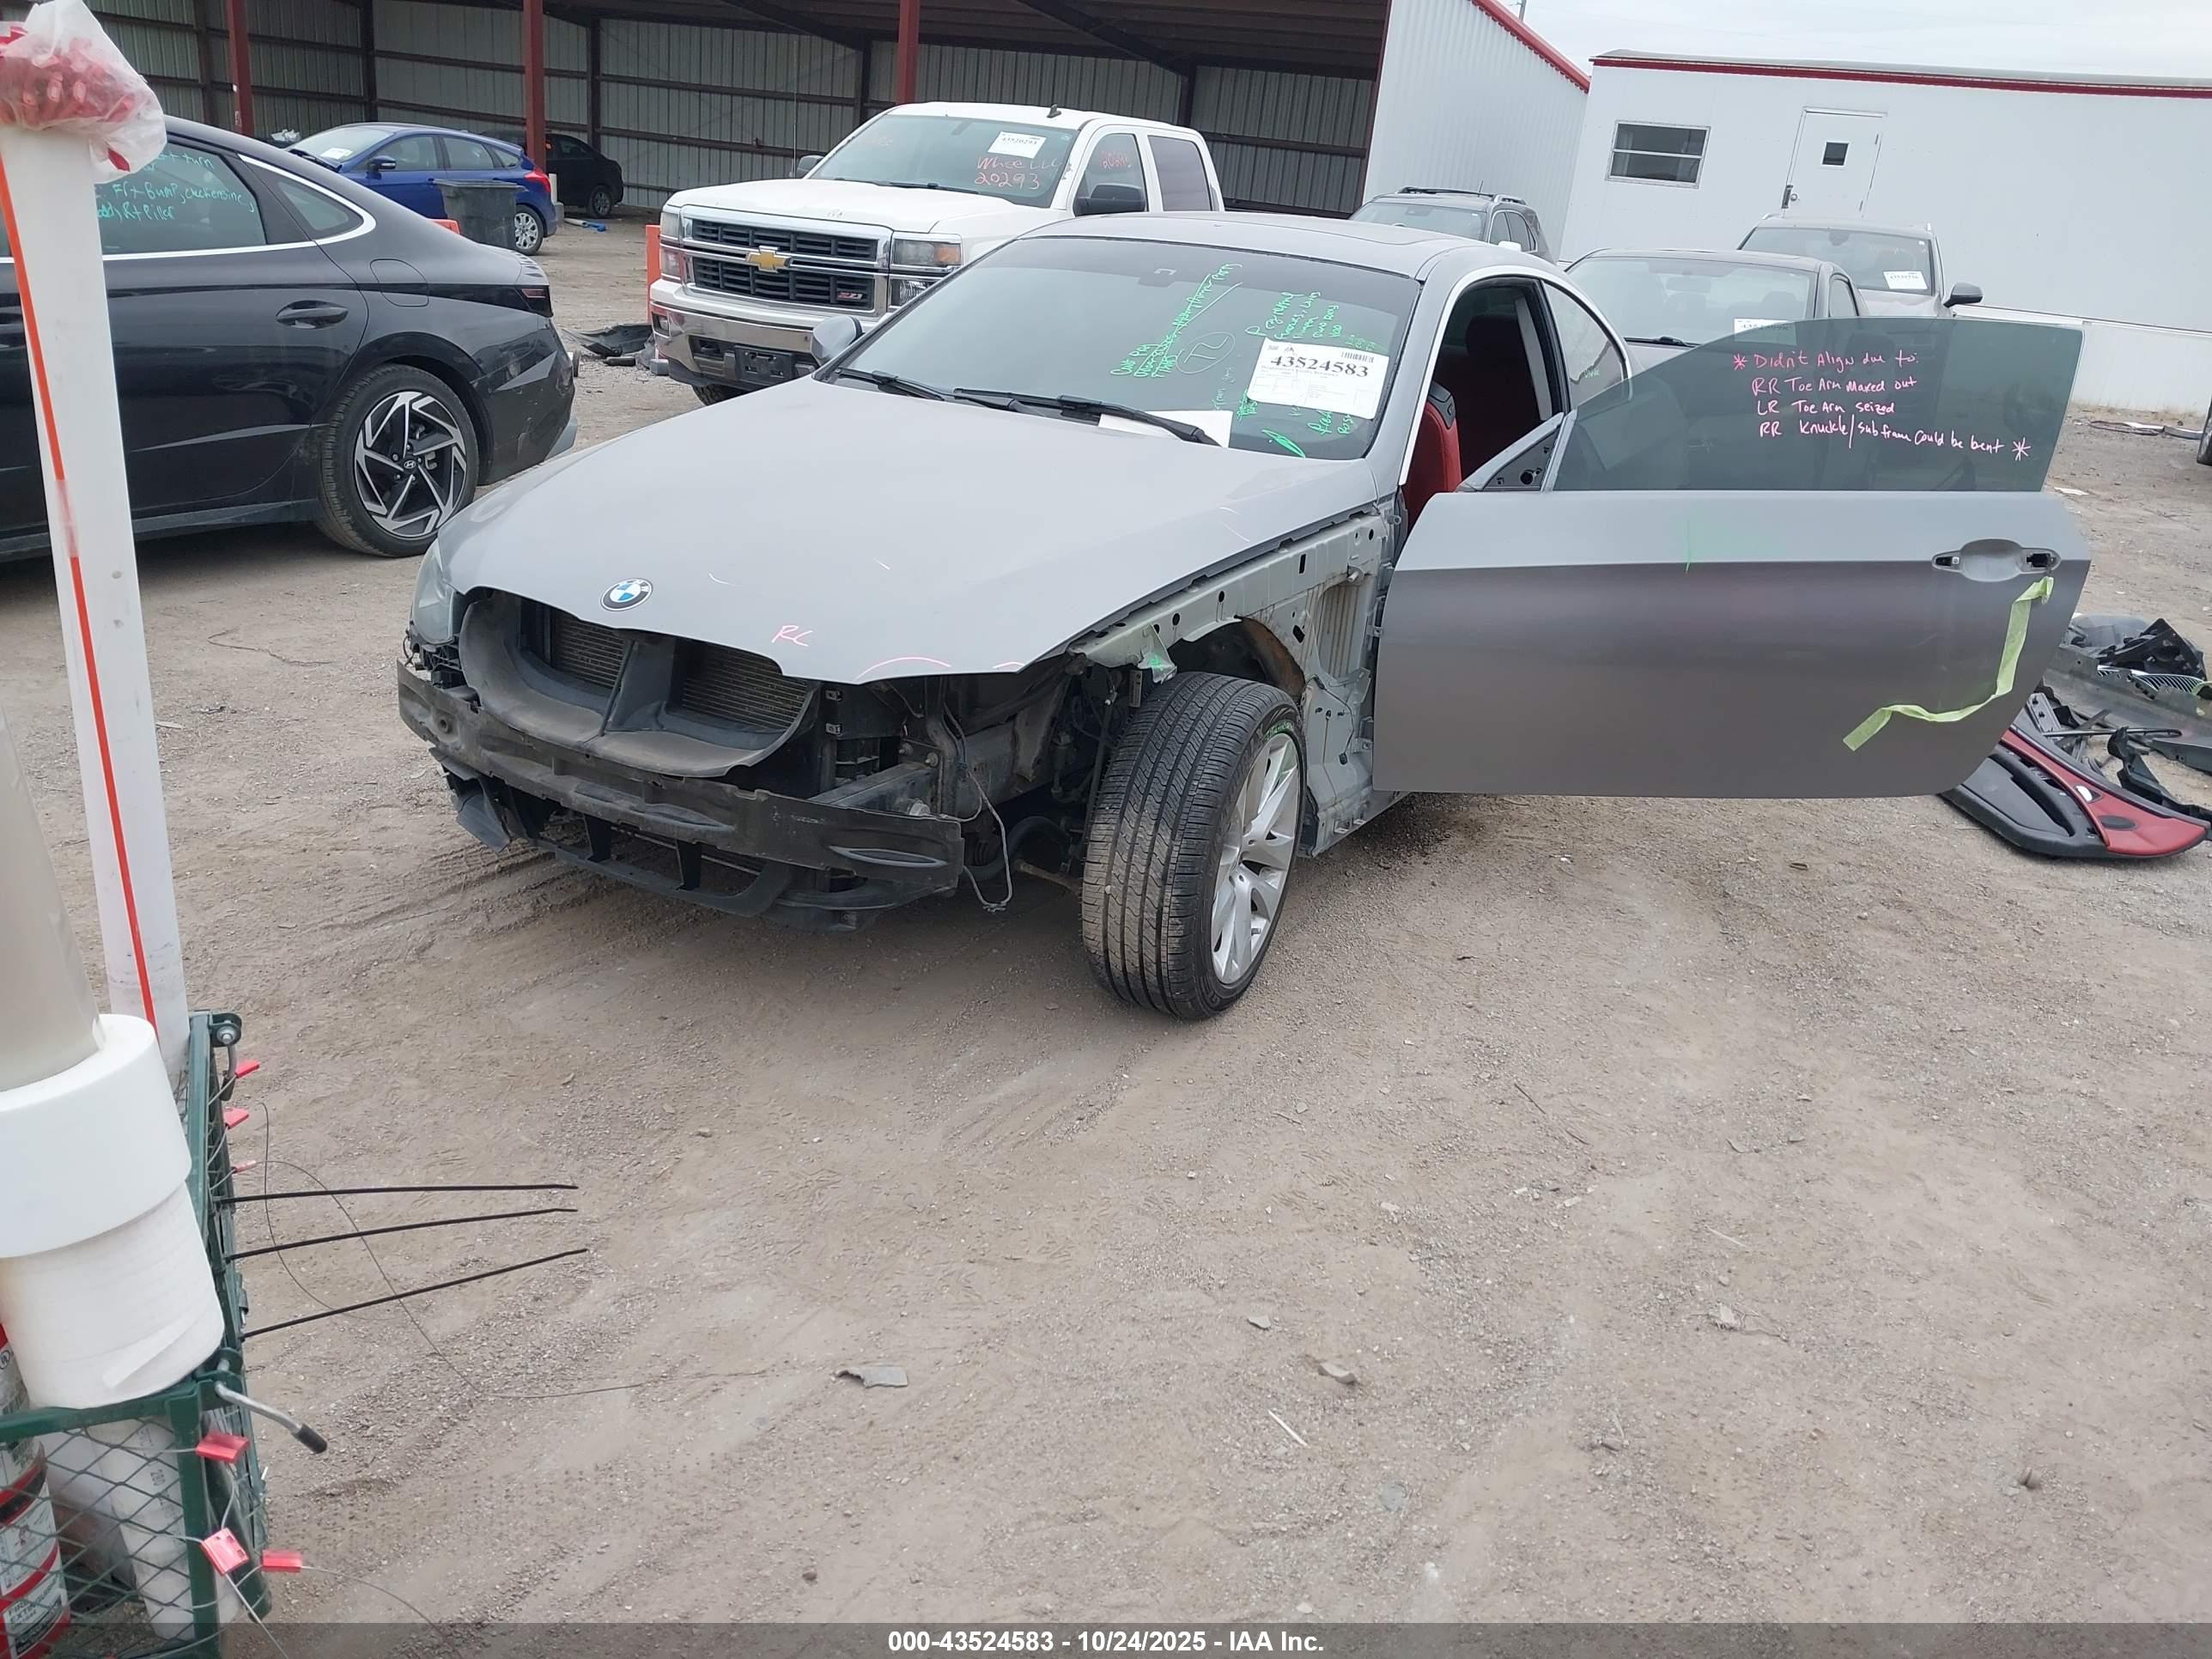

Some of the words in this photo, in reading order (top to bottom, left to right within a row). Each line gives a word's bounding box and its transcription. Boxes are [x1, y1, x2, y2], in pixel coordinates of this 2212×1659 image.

[974, 173, 1040, 190] 20293
[1270, 355, 1369, 378] 43524583
[1863, 352, 1886, 365] due
[1752, 377, 1781, 397] RR
[1784, 376, 1814, 392] Toe
[1818, 378, 1842, 392] Arm
[1894, 376, 1917, 390] out
[1757, 399, 1780, 416] LR
[1791, 399, 1819, 414] Toe
[1822, 404, 1845, 414] Arm
[1759, 421, 1783, 437] RR
[1951, 430, 1965, 448] be
[1971, 435, 2005, 453] bent
